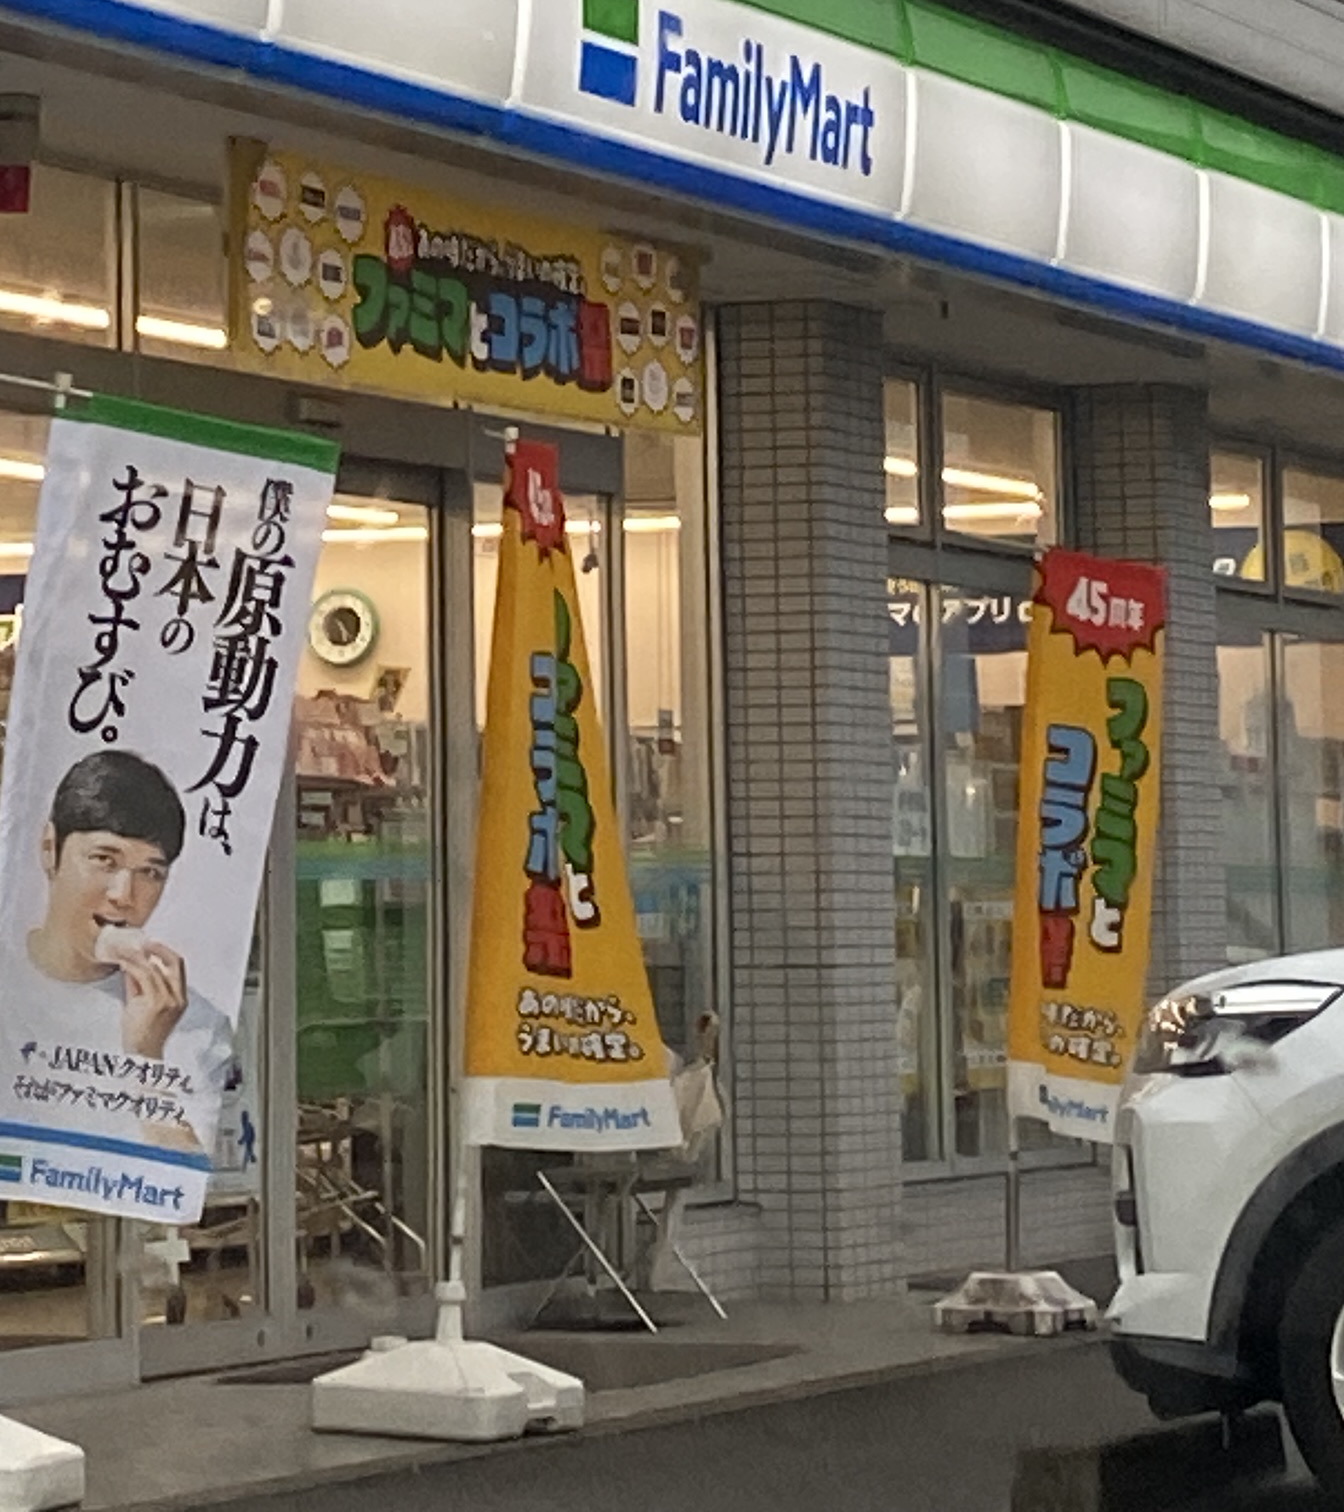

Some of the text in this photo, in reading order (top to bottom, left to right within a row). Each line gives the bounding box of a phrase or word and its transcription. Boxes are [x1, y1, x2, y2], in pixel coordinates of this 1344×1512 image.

[654, 10, 874, 176] FamilyMart
[68, 464, 169, 743] おむすび。
[153, 477, 227, 655] 日本の
[1067, 576, 1145, 631] 45周年
[183, 477, 296, 856] 僕の原動力は、
[1091, 677, 1149, 953] ファミマと
[30, 1158, 186, 1210] FamilyMart
[546, 1104, 651, 1134] FamilyMart
